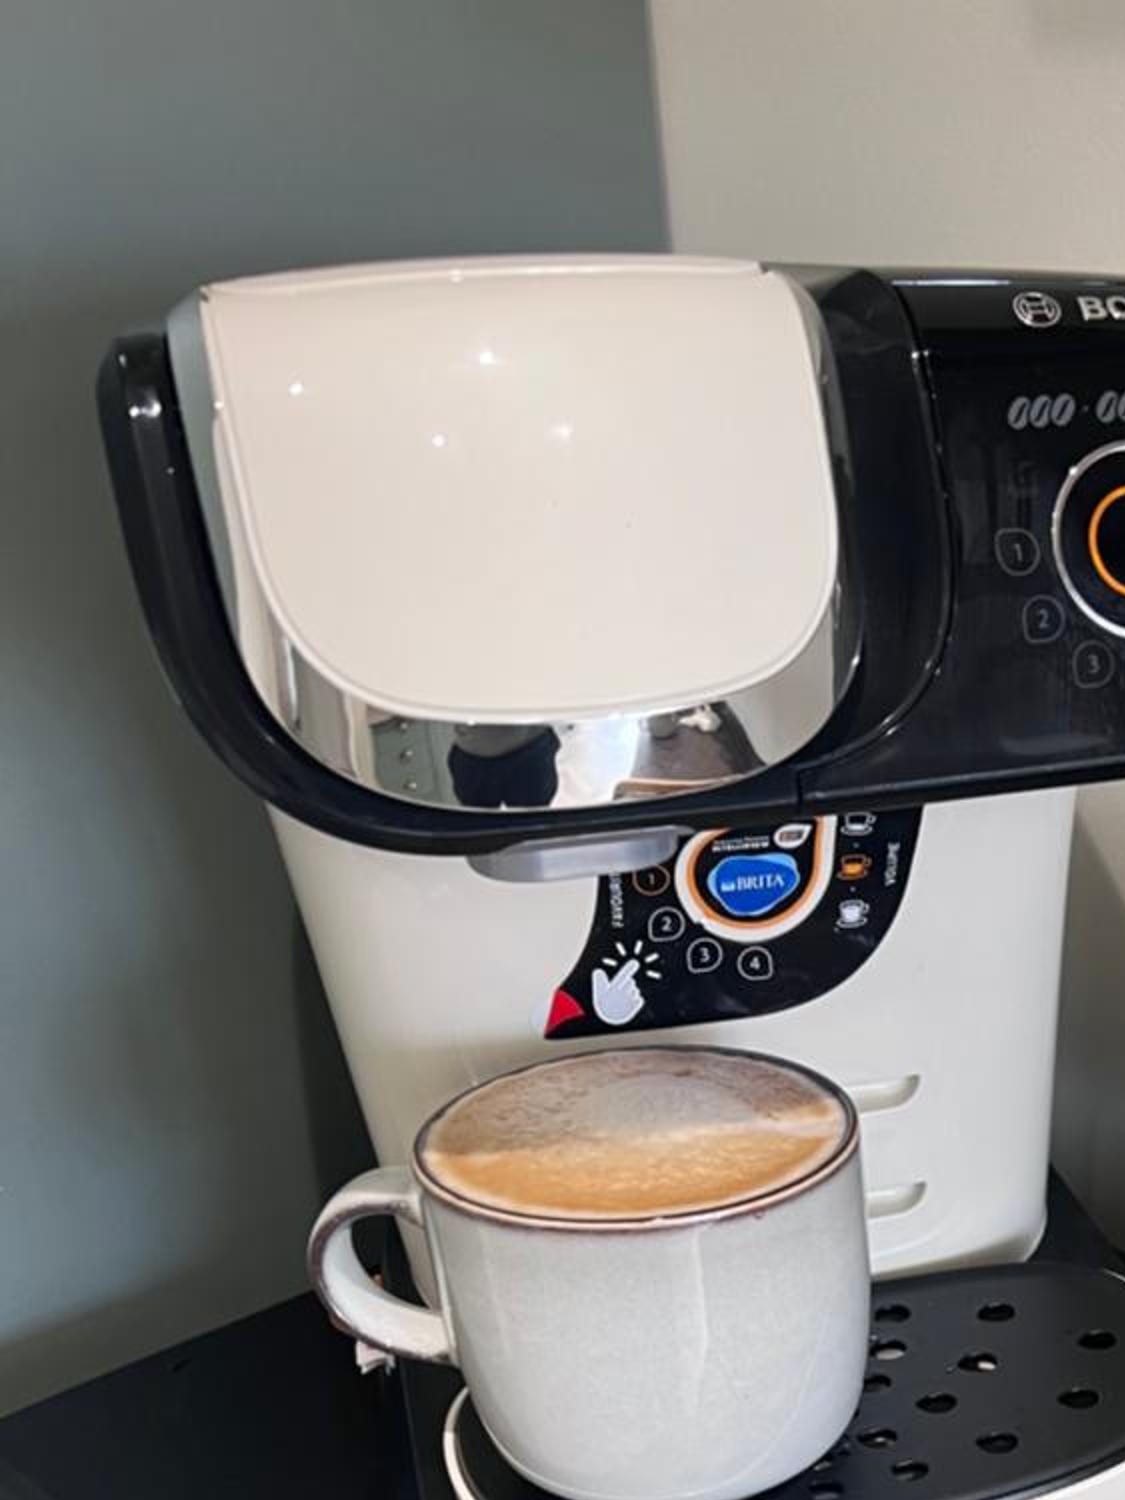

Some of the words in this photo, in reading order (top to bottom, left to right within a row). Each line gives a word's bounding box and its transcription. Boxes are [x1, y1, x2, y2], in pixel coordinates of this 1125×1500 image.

[1037, 608, 1050, 629] 2
[1087, 654, 1100, 674] 3
[736, 872, 786, 892] BRITA
[661, 916, 673, 932] 2
[700, 946, 710, 963] 3
[748, 956, 761, 971] 4
